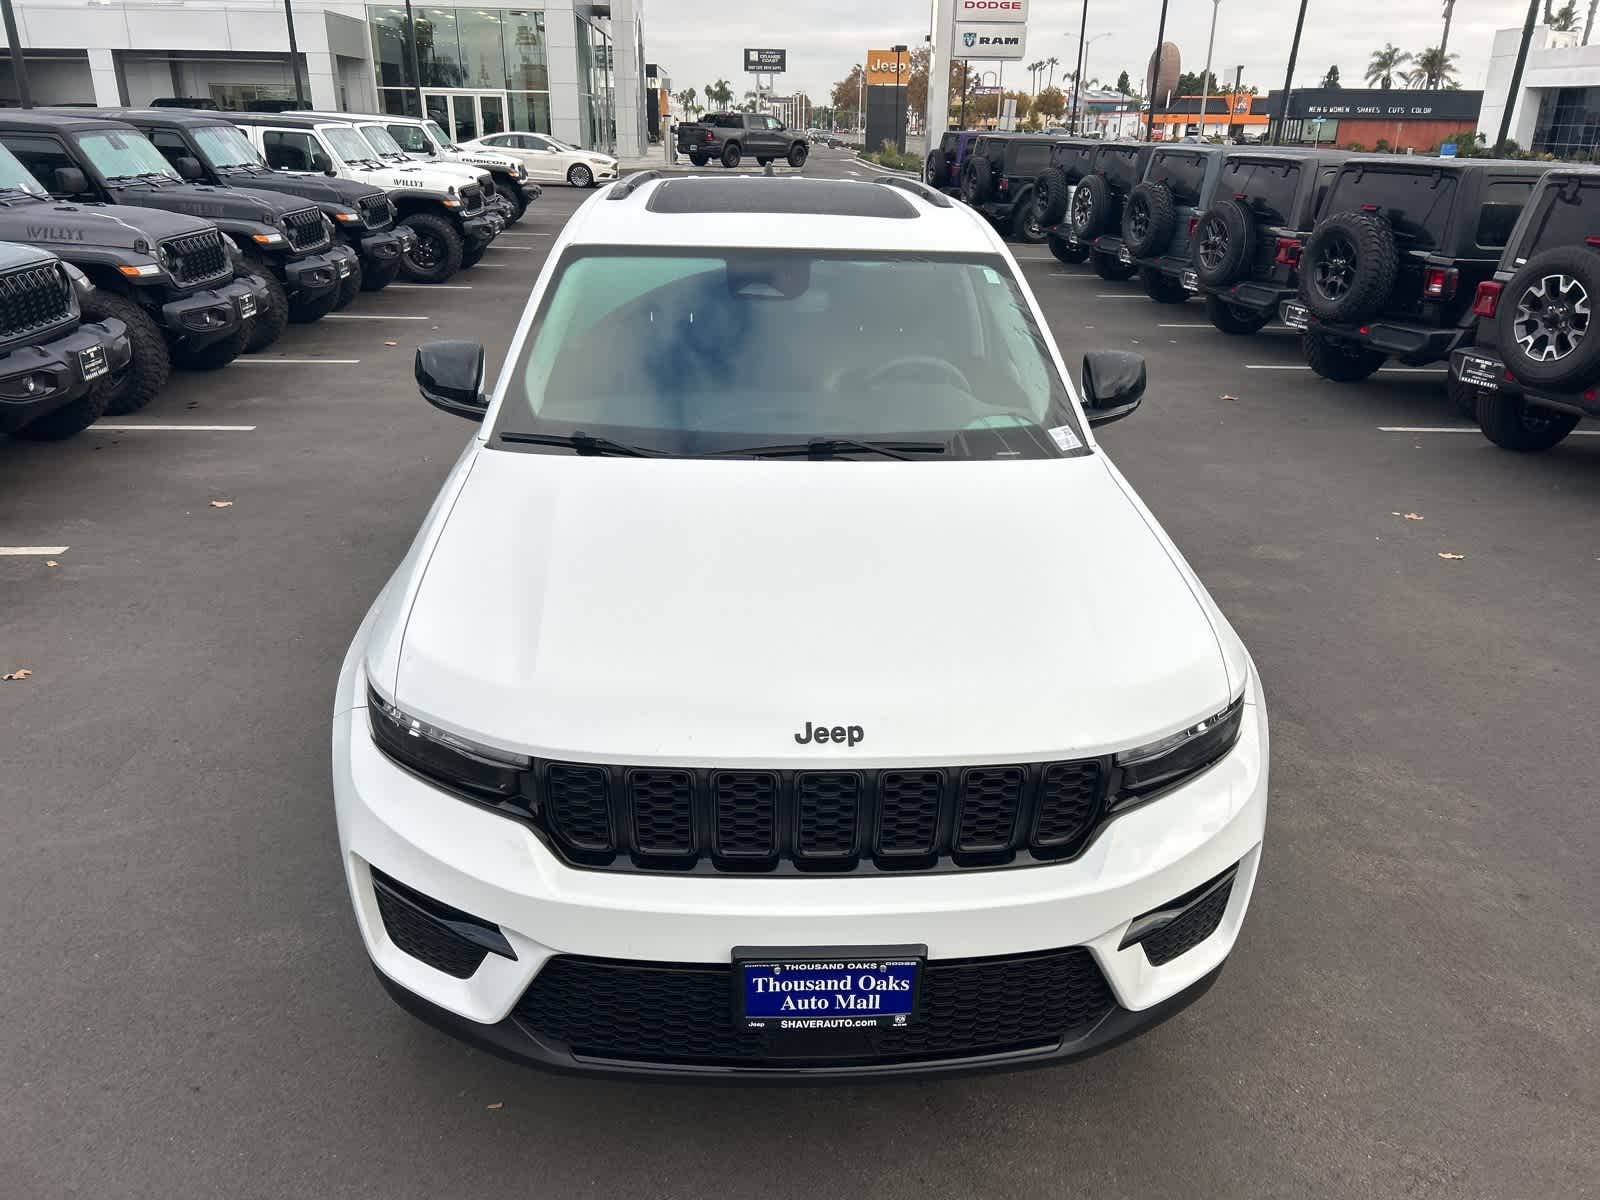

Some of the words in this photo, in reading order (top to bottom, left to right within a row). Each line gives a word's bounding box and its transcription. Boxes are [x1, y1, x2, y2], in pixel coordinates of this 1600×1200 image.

[964, 1, 1022, 10] DODGE
[979, 37, 1019, 45] RAM
[871, 59, 906, 75] Jeep
[1388, 106, 1405, 114] CUTS
[393, 178, 425, 188] WILLYS
[25, 223, 85, 240] WILLYS
[794, 721, 864, 747] Jeep
[784, 963, 845, 971] THOUSAND
[847, 962, 878, 970] OAKS
[752, 975, 852, 993] Thousand
[858, 974, 910, 991] Oaks
[780, 994, 829, 1011] Auto
[834, 994, 881, 1010] Mall
[780, 1018, 877, 1029] SHAVERAUTO.com
